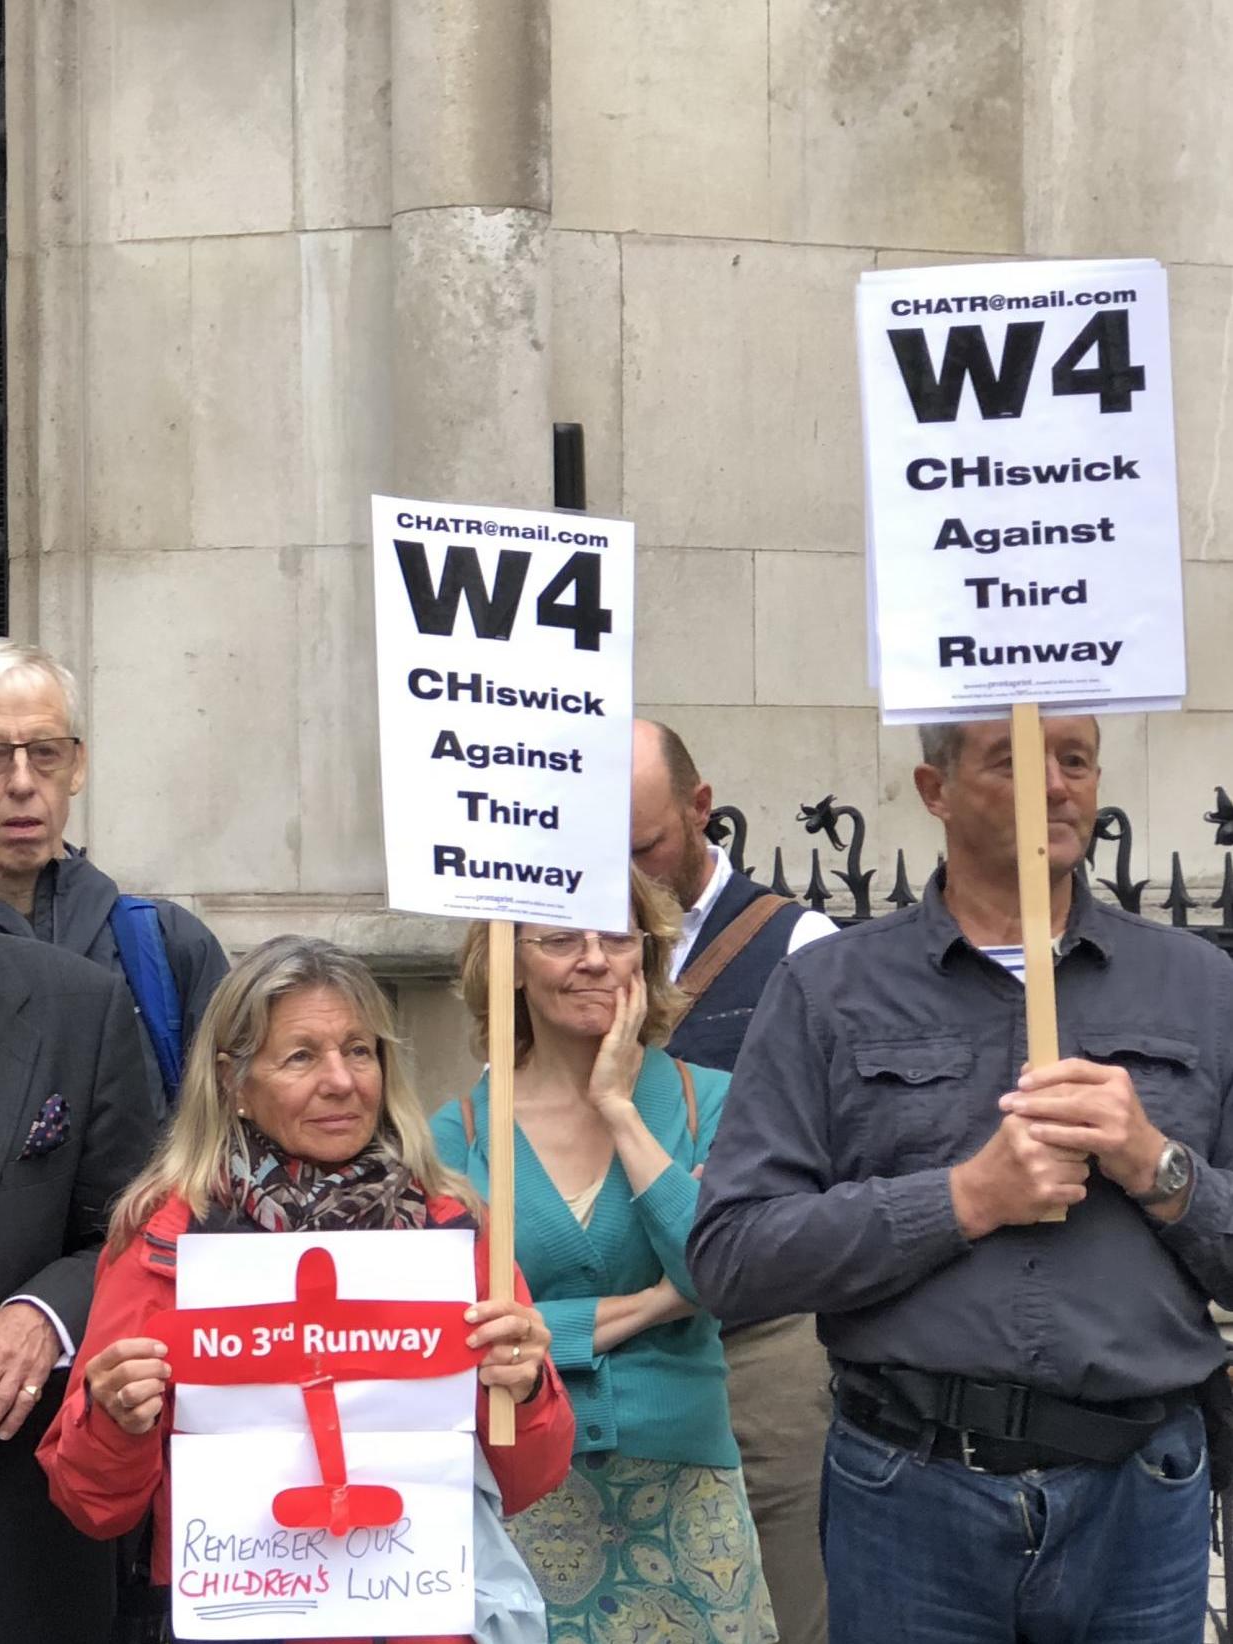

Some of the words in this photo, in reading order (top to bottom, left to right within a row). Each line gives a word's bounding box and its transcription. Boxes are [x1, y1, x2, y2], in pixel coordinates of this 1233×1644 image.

[891, 288, 1137, 316] CHATR@mail.com
[886, 309, 1146, 423] W4
[905, 455, 1140, 491] CHiswick
[396, 512, 608, 548] CHATR@mail.com
[934, 517, 1115, 554] Against
[393, 539, 612, 652] W4
[965, 578, 1087, 609] Third
[939, 636, 1123, 668] Runway
[408, 668, 605, 716] CHiswick
[431, 730, 582, 773] Against
[457, 791, 559, 829] Third
[433, 845, 582, 893] Runway
[192, 1327, 242, 1358] No
[251, 1323, 295, 1356] 3rd
[303, 1325, 441, 1358] Runway
[183, 1519, 328, 1567] REMEMBER
[346, 1517, 414, 1559] OUR
